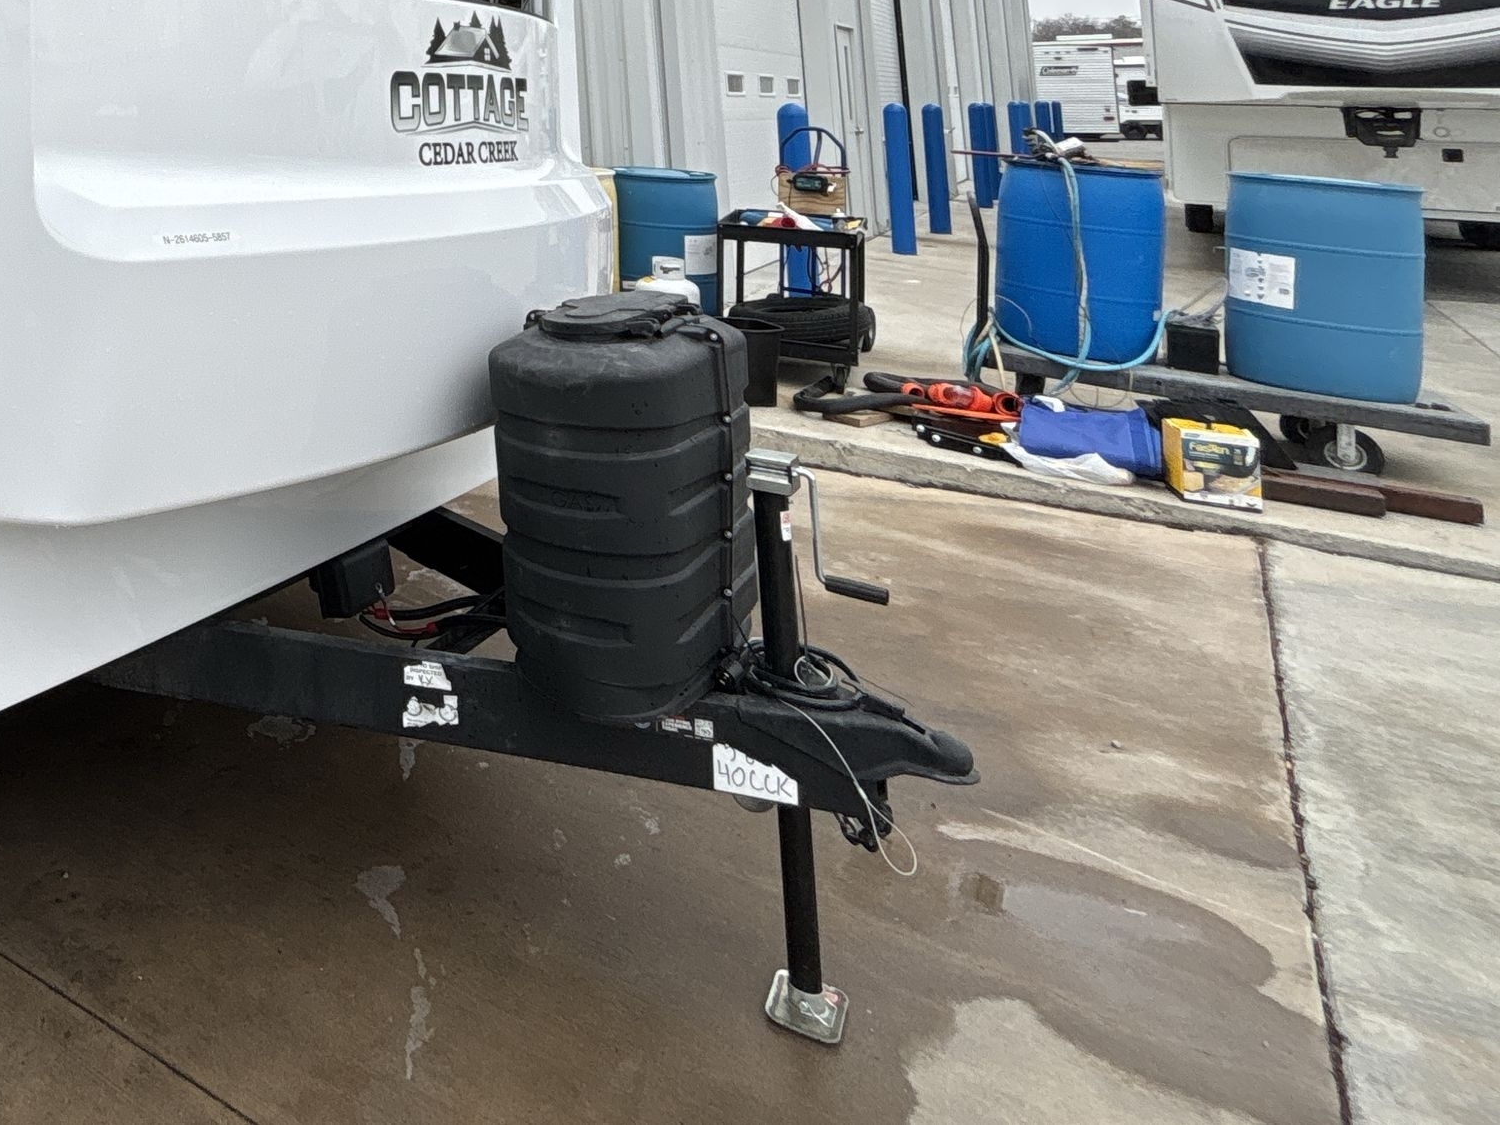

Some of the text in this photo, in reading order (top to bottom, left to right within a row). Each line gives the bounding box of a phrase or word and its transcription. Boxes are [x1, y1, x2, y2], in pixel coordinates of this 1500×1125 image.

[390, 71, 529, 133] COTTAGE
[419, 141, 518, 166] CEDAR CREEK
